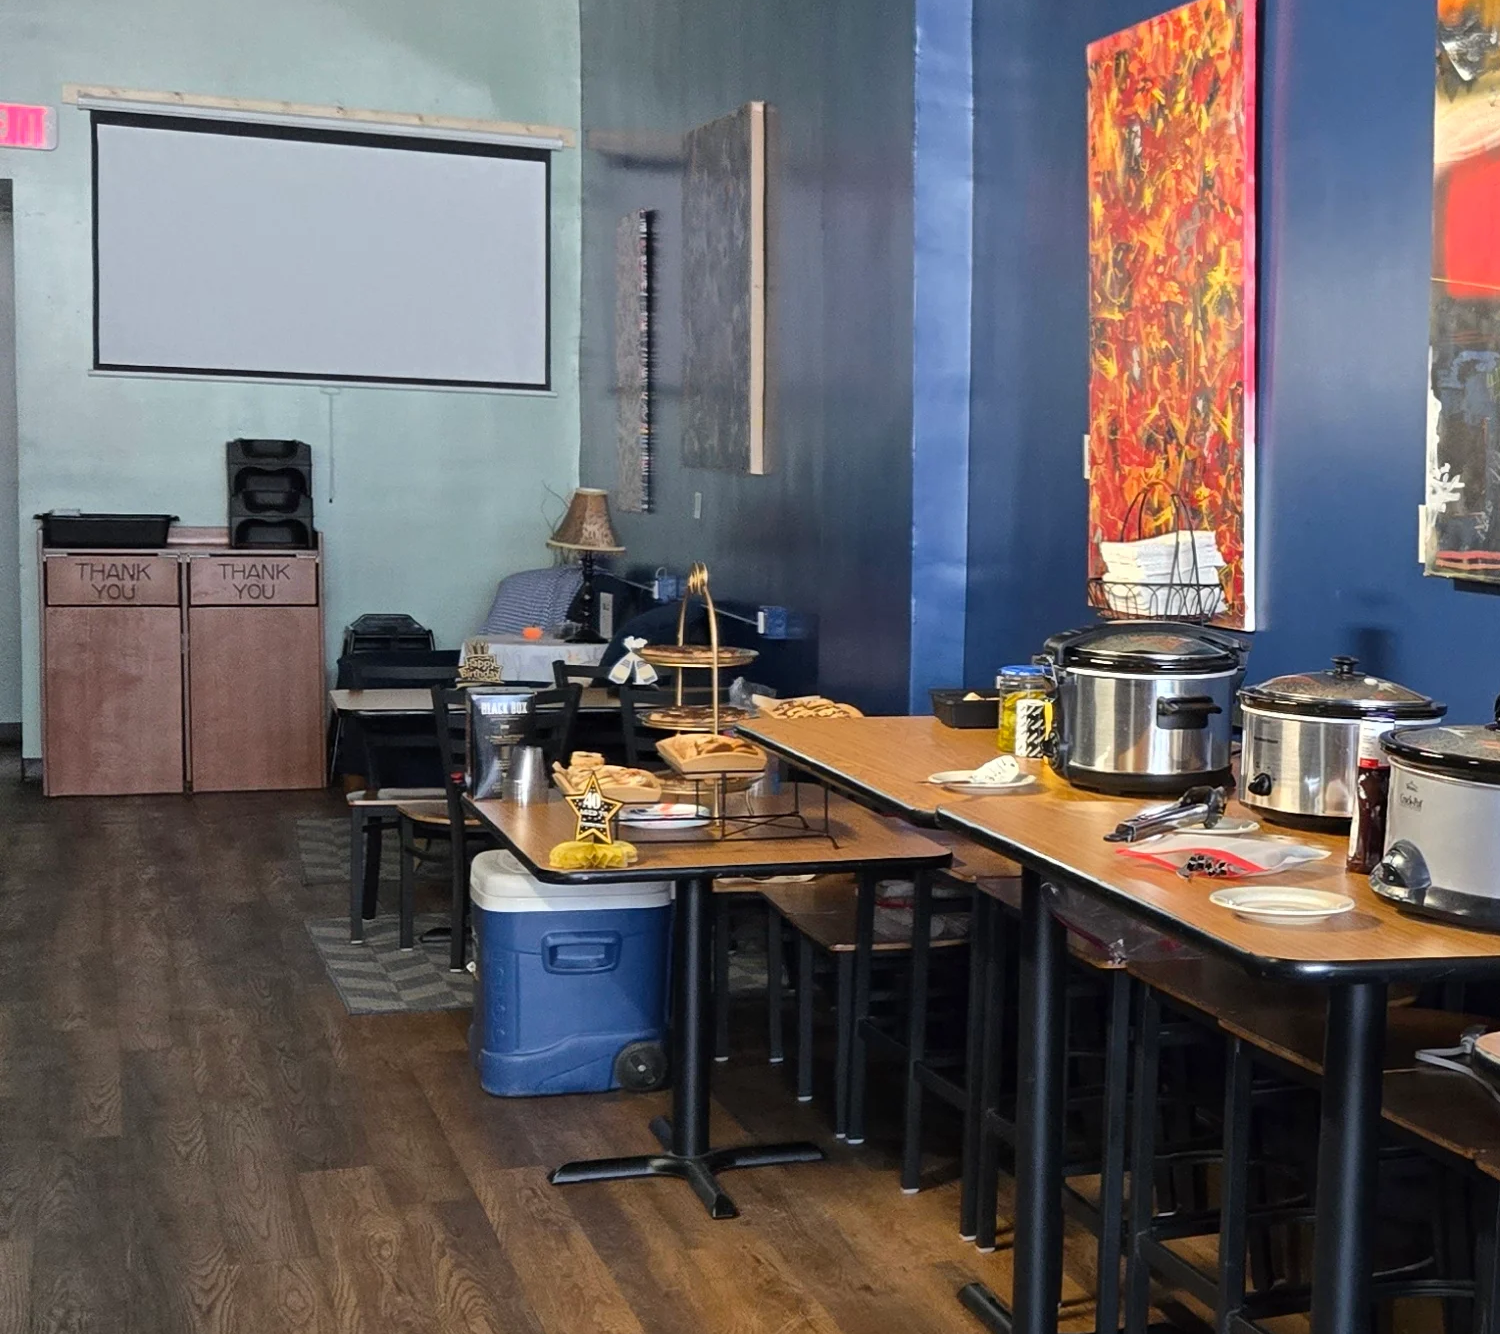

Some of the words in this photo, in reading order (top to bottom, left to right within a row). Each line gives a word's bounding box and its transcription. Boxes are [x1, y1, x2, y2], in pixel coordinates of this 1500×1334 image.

[75, 562, 152, 581] THANK
[217, 563, 291, 580] THANK
[91, 583, 136, 601] YOU
[232, 583, 276, 600] YOU
[465, 658, 496, 670] Happy
[460, 667, 500, 680] Birthday
[481, 701, 509, 715] BLACK
[511, 701, 528, 715] BOX
[583, 792, 602, 809] 40
